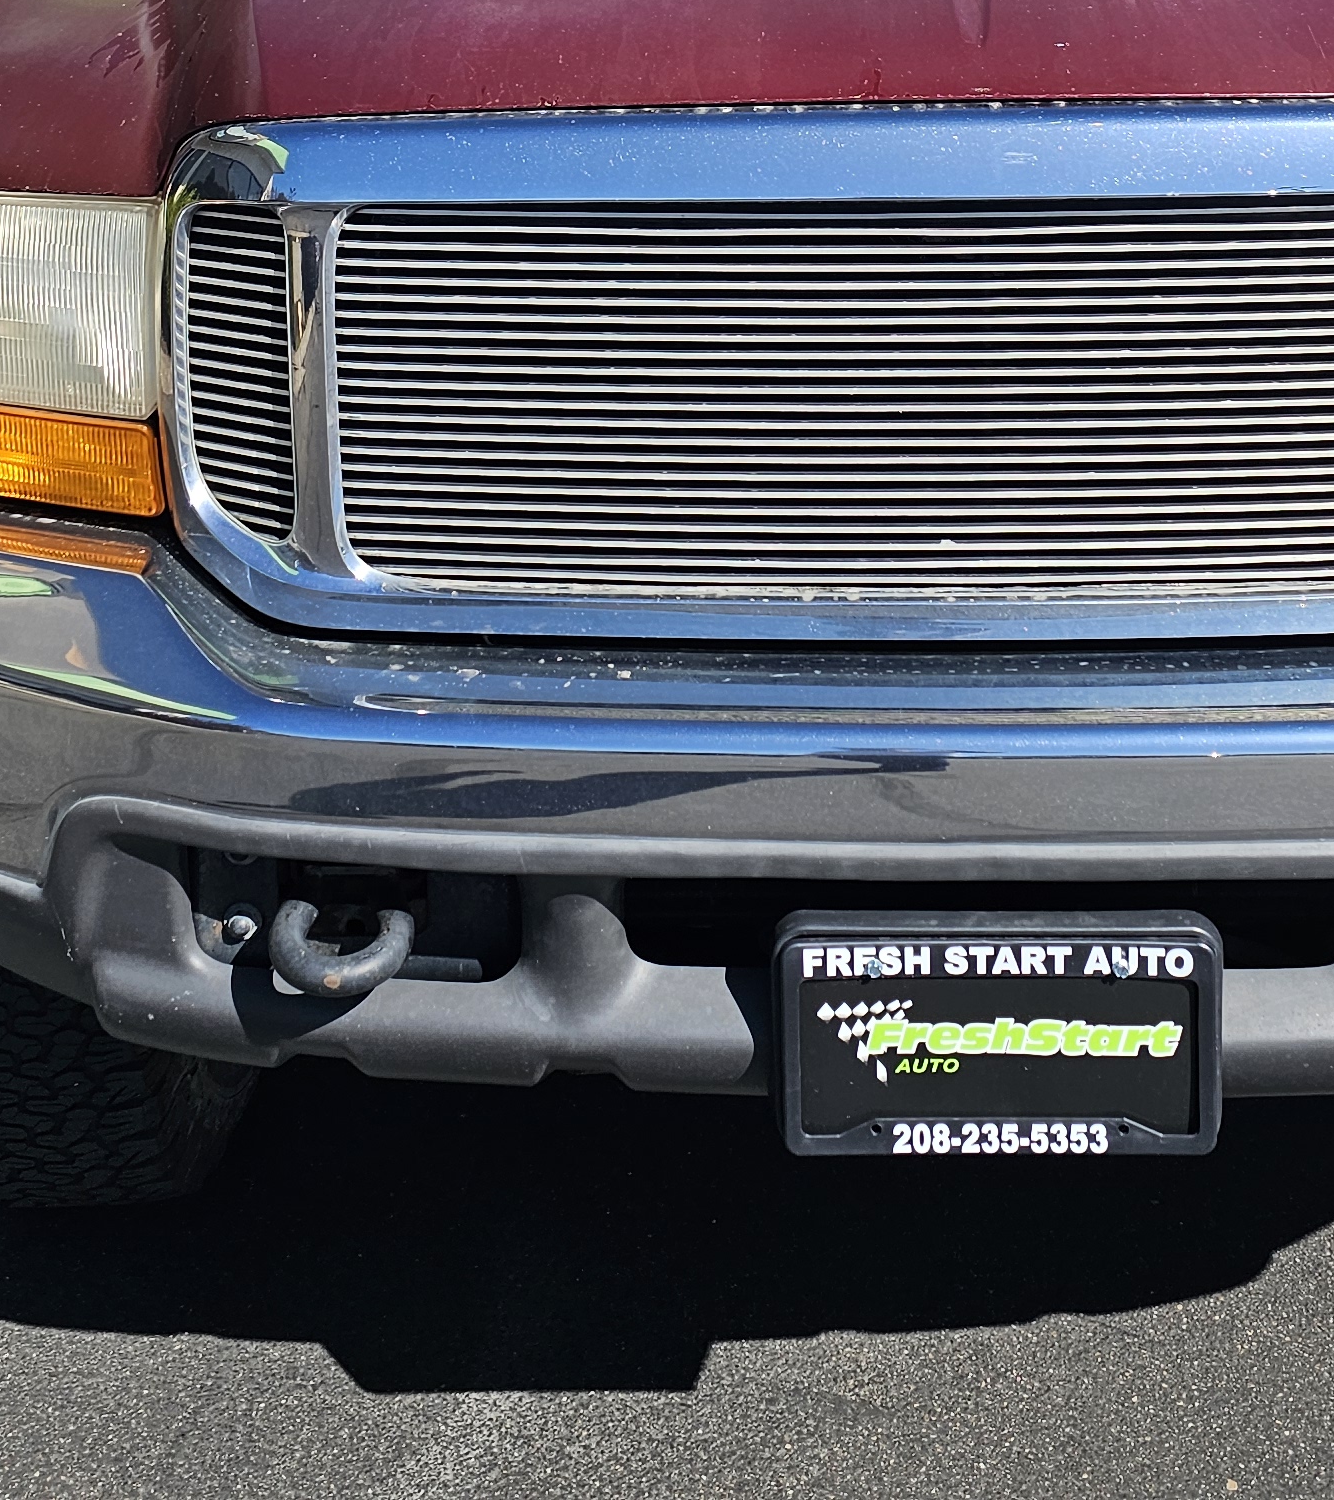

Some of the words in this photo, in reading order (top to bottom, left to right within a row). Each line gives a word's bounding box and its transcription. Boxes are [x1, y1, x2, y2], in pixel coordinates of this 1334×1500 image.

[802, 945, 931, 978] FRESH
[943, 945, 1073, 976] START
[1083, 945, 1194, 978] AUTO
[866, 1017, 1184, 1058] FreshStart
[895, 1058, 960, 1074] AUTO
[892, 1122, 1109, 1155] 208-235-5353
